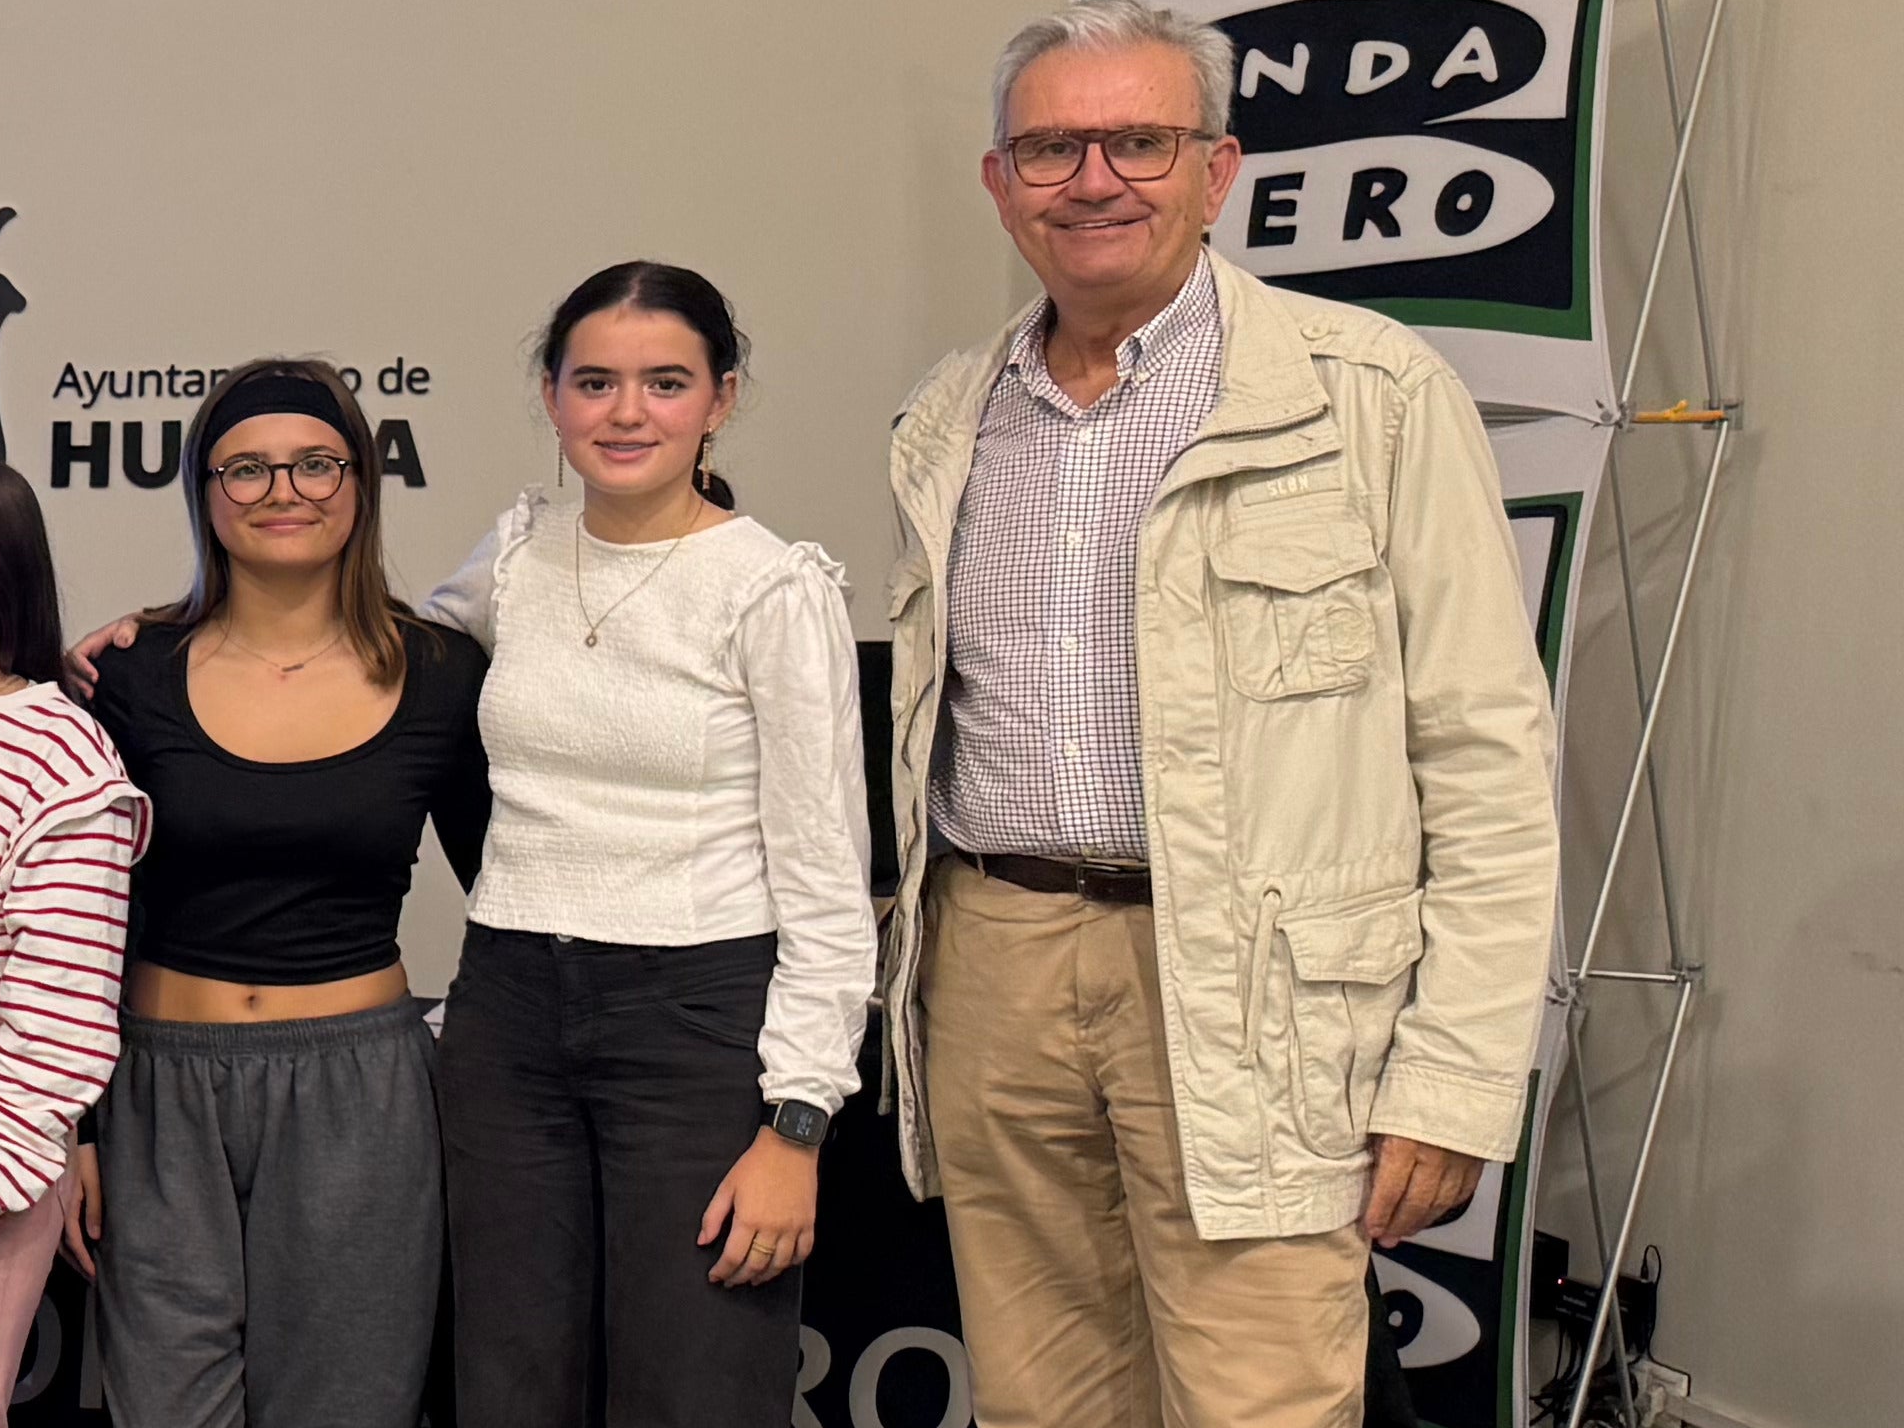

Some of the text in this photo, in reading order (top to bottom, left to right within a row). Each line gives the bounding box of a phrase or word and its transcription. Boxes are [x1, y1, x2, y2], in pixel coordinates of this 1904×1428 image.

[1239, 25, 1499, 99] NDA
[1246, 166, 1495, 249] ERO
[376, 355, 432, 396] de
[50, 418, 427, 489] HUA
